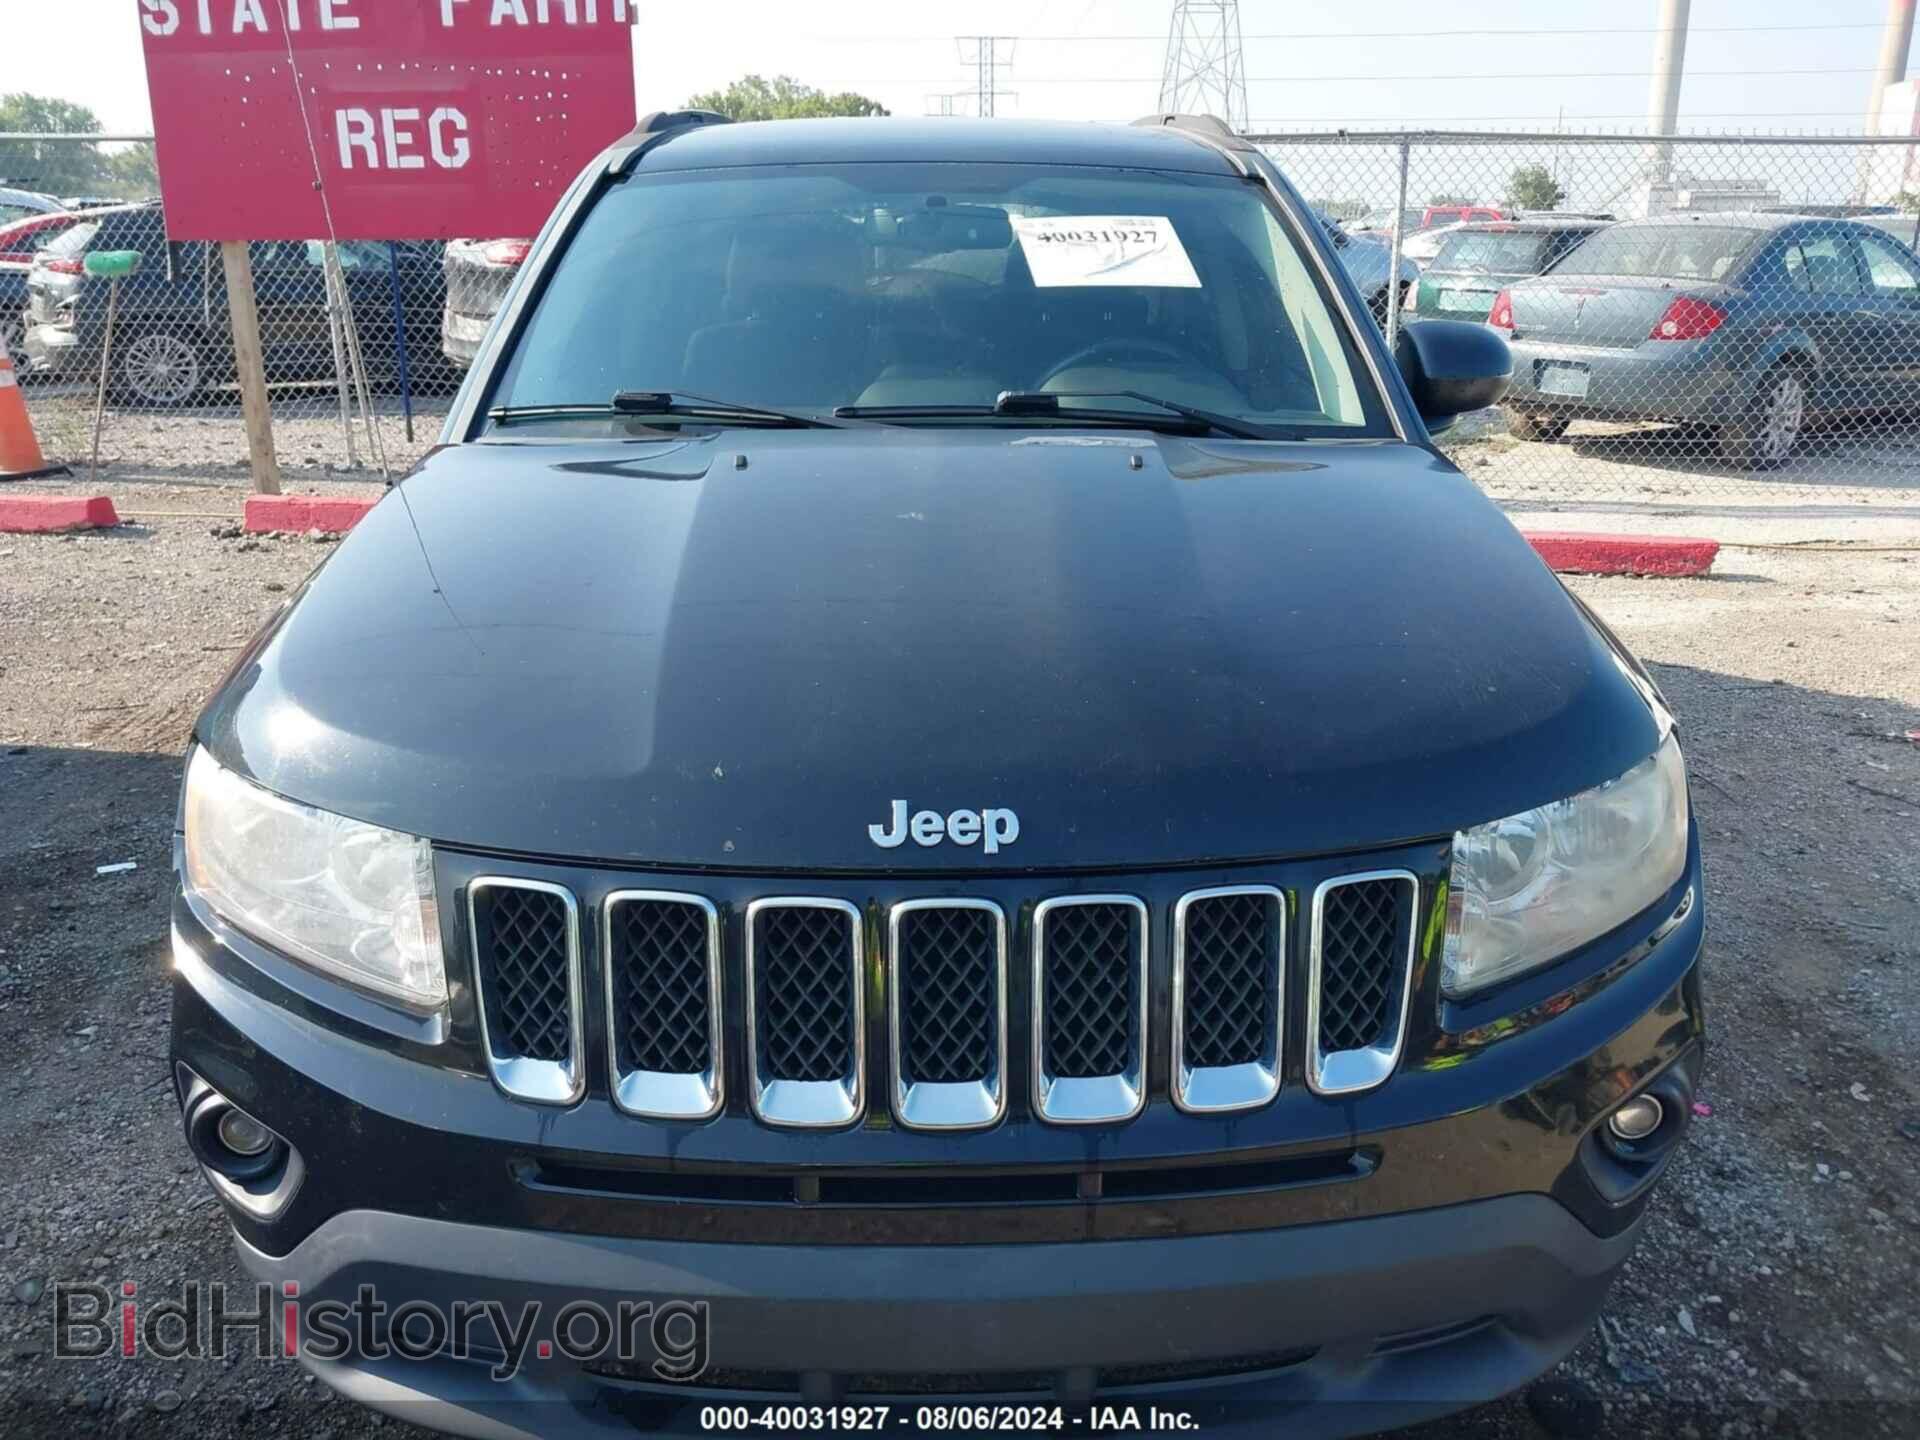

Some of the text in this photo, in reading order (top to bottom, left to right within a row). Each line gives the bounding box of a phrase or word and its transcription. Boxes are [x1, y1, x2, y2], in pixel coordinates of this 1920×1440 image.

[335, 107, 471, 169] REG
[1037, 230, 1158, 244] 40031927
[868, 799, 1020, 854] Jeep
